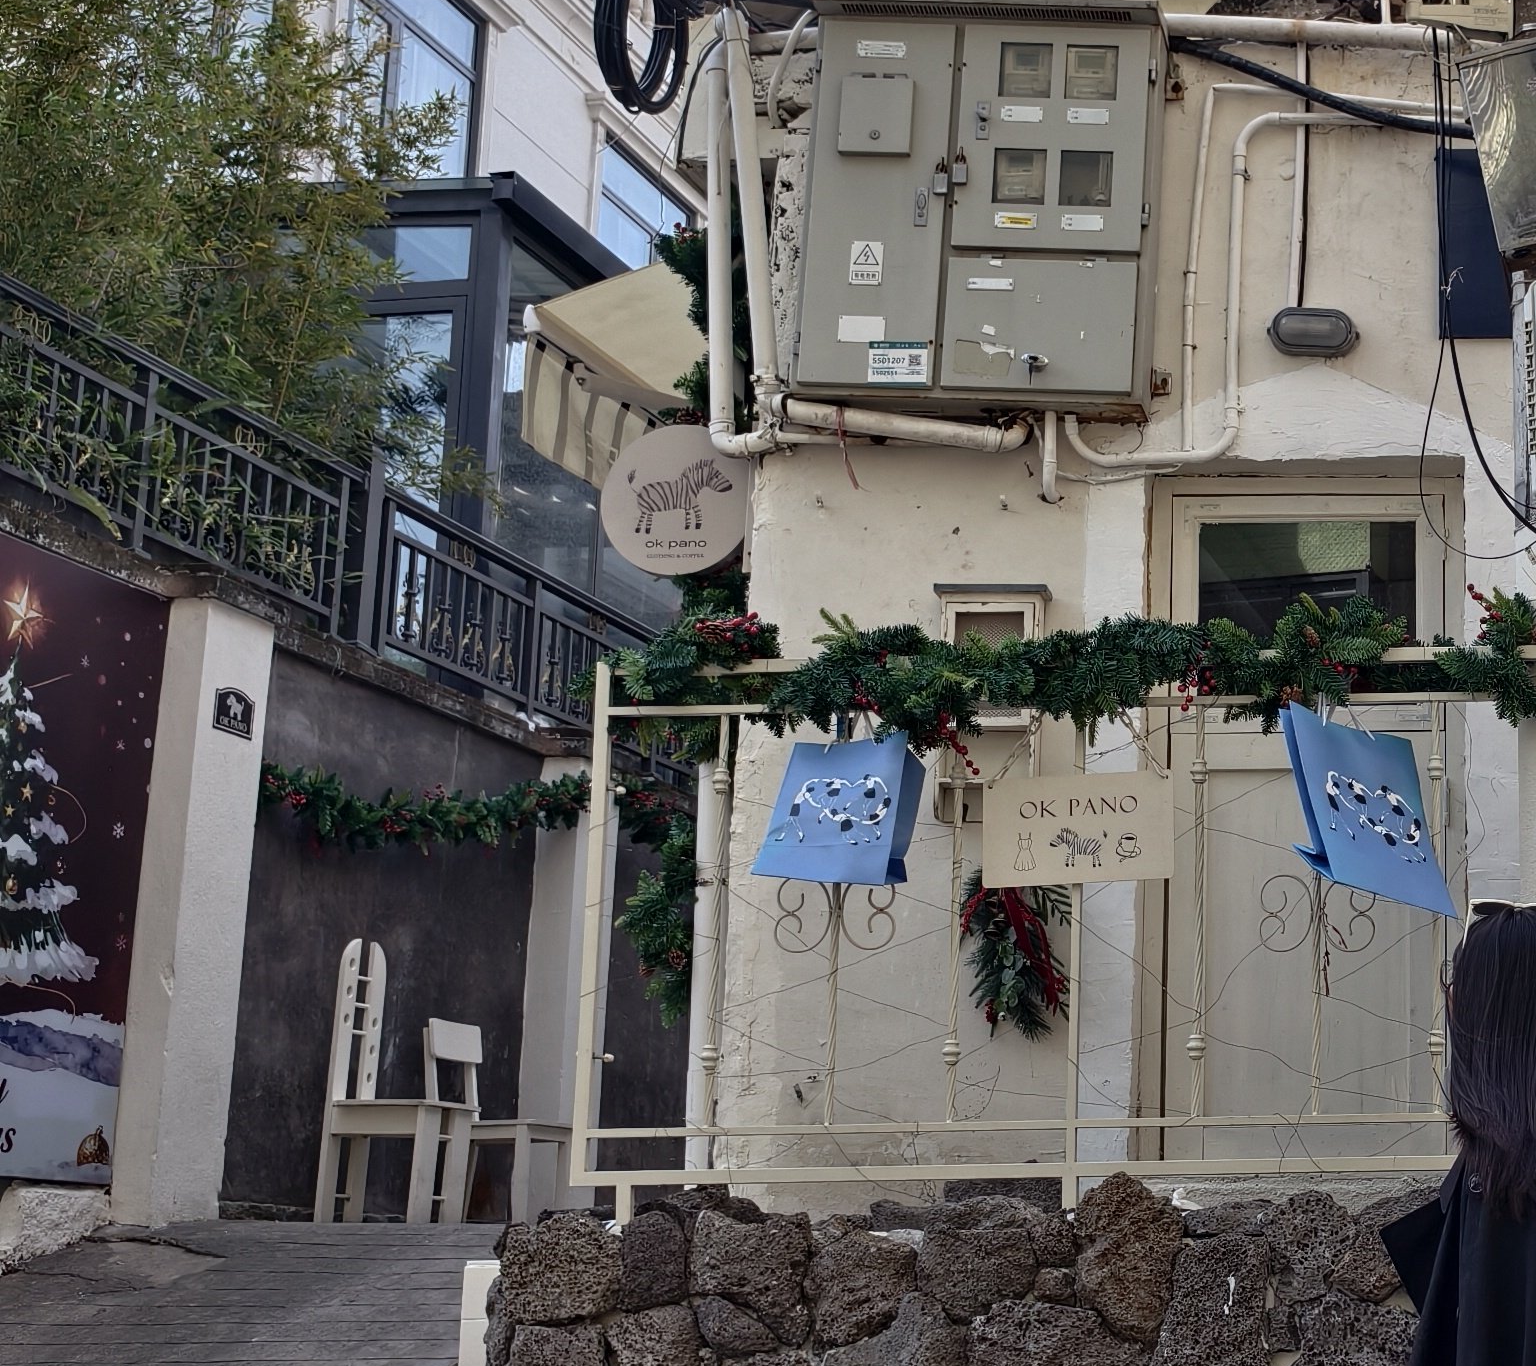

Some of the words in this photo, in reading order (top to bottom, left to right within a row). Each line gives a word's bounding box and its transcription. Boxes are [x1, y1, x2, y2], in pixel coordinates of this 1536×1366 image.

[645, 539, 663, 548] ok
[668, 540, 707, 550] pano
[219, 716, 230, 726] OK
[230, 720, 248, 732] PANO
[1019, 799, 1057, 819] OK
[1069, 795, 1138, 817] PANO
